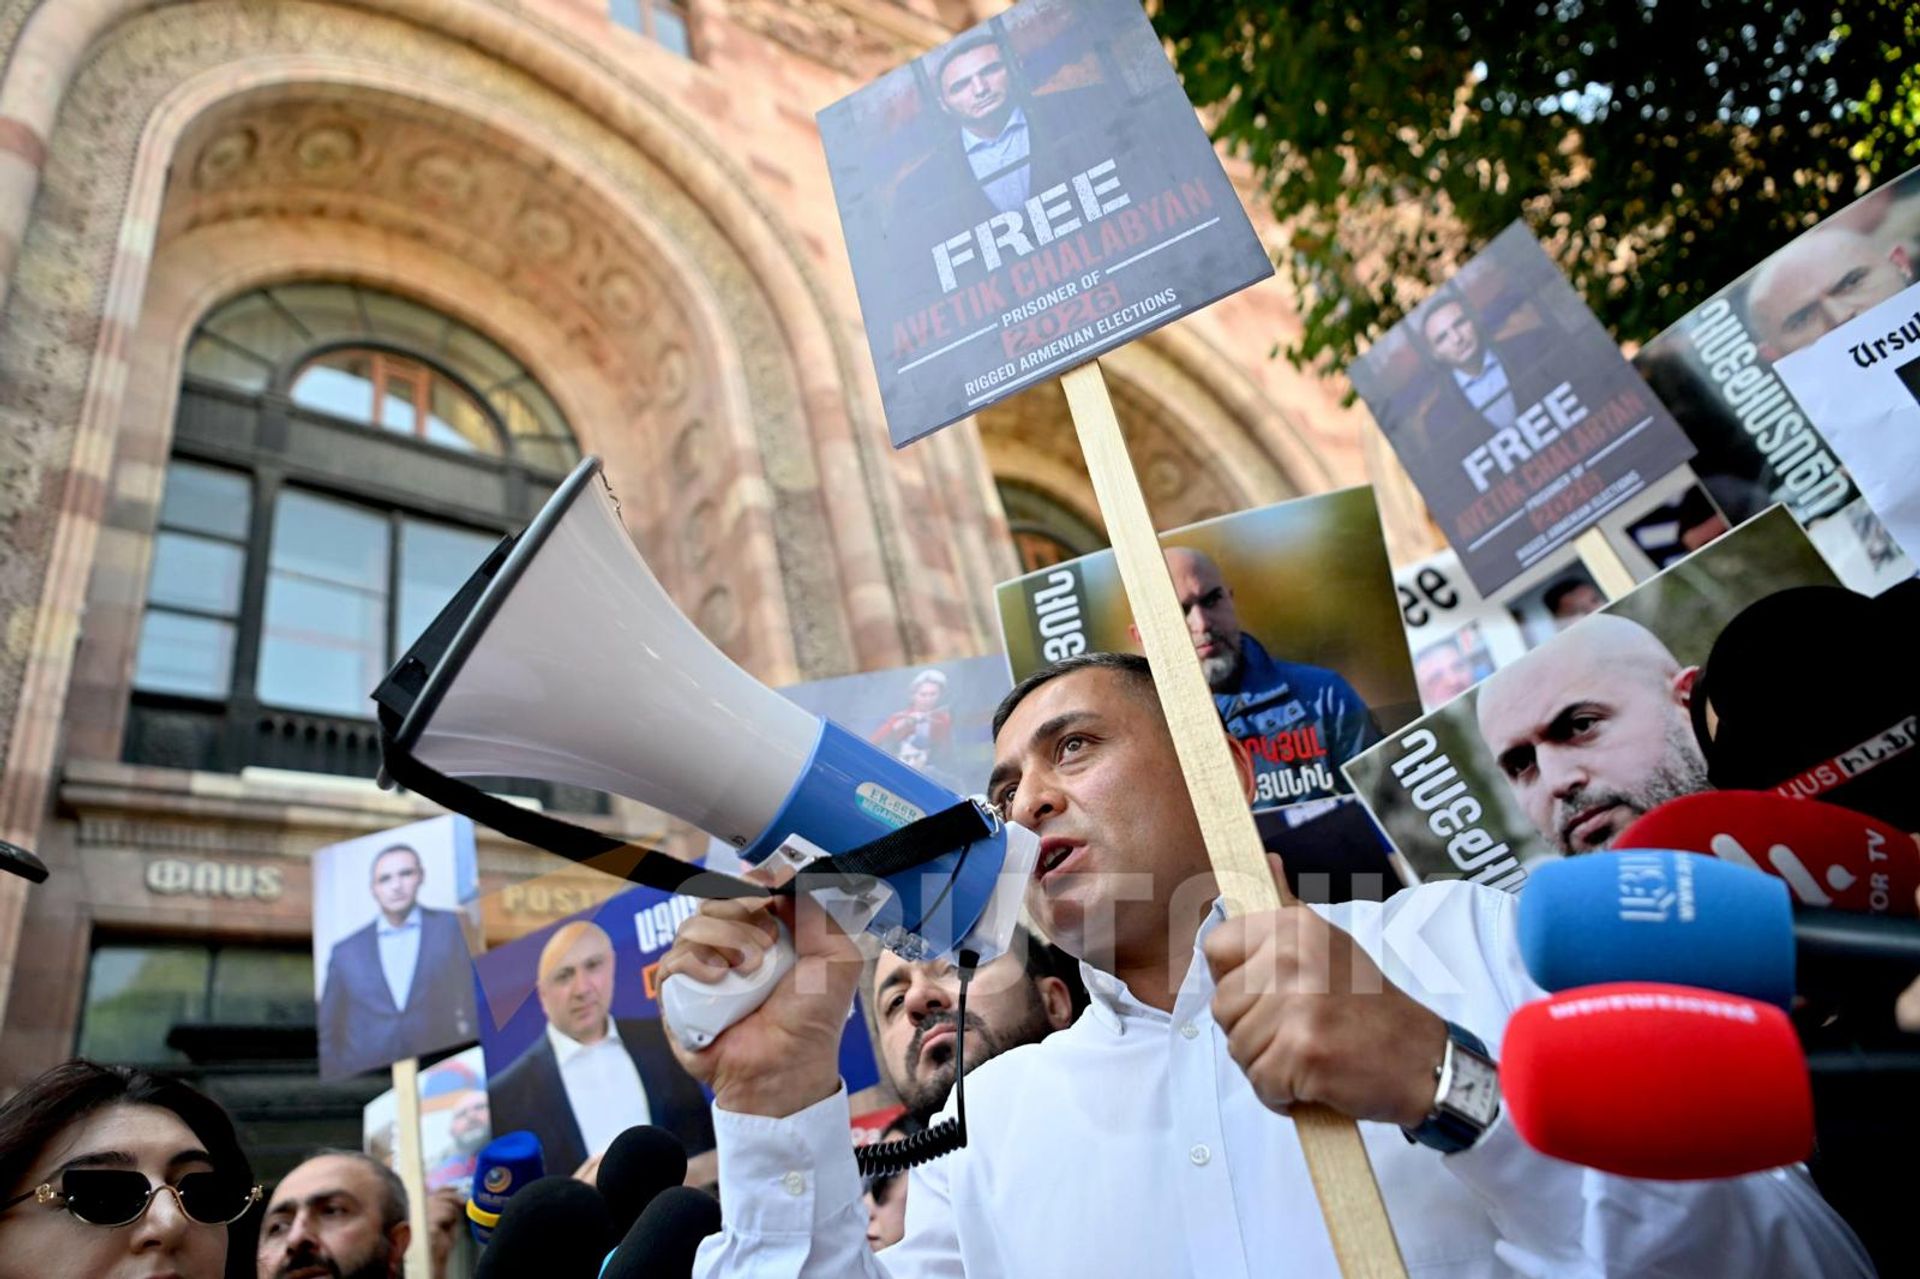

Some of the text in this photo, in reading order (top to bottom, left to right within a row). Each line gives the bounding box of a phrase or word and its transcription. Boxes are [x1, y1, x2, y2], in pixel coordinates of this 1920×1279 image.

[891, 177, 1213, 358] AVETIK CHALABYAN
[931, 158, 1131, 293] FREE
[1002, 269, 1101, 328] PRISONER OF
[964, 287, 1177, 397] RIGGED ARMENIAN ELECTIONS
[1461, 381, 1590, 493] FREE
[1690, 298, 1850, 518] ԱԶԱՏՈՒԹՅՈՒՆ
[1254, 762, 1334, 803] ՅԱՆԻՆ
[146, 859, 282, 900] ՓՈՍՏ
[503, 883, 600, 913] POST
[1865, 828, 1889, 913] OR TV
[634, 895, 698, 954] ԱԶԱ
